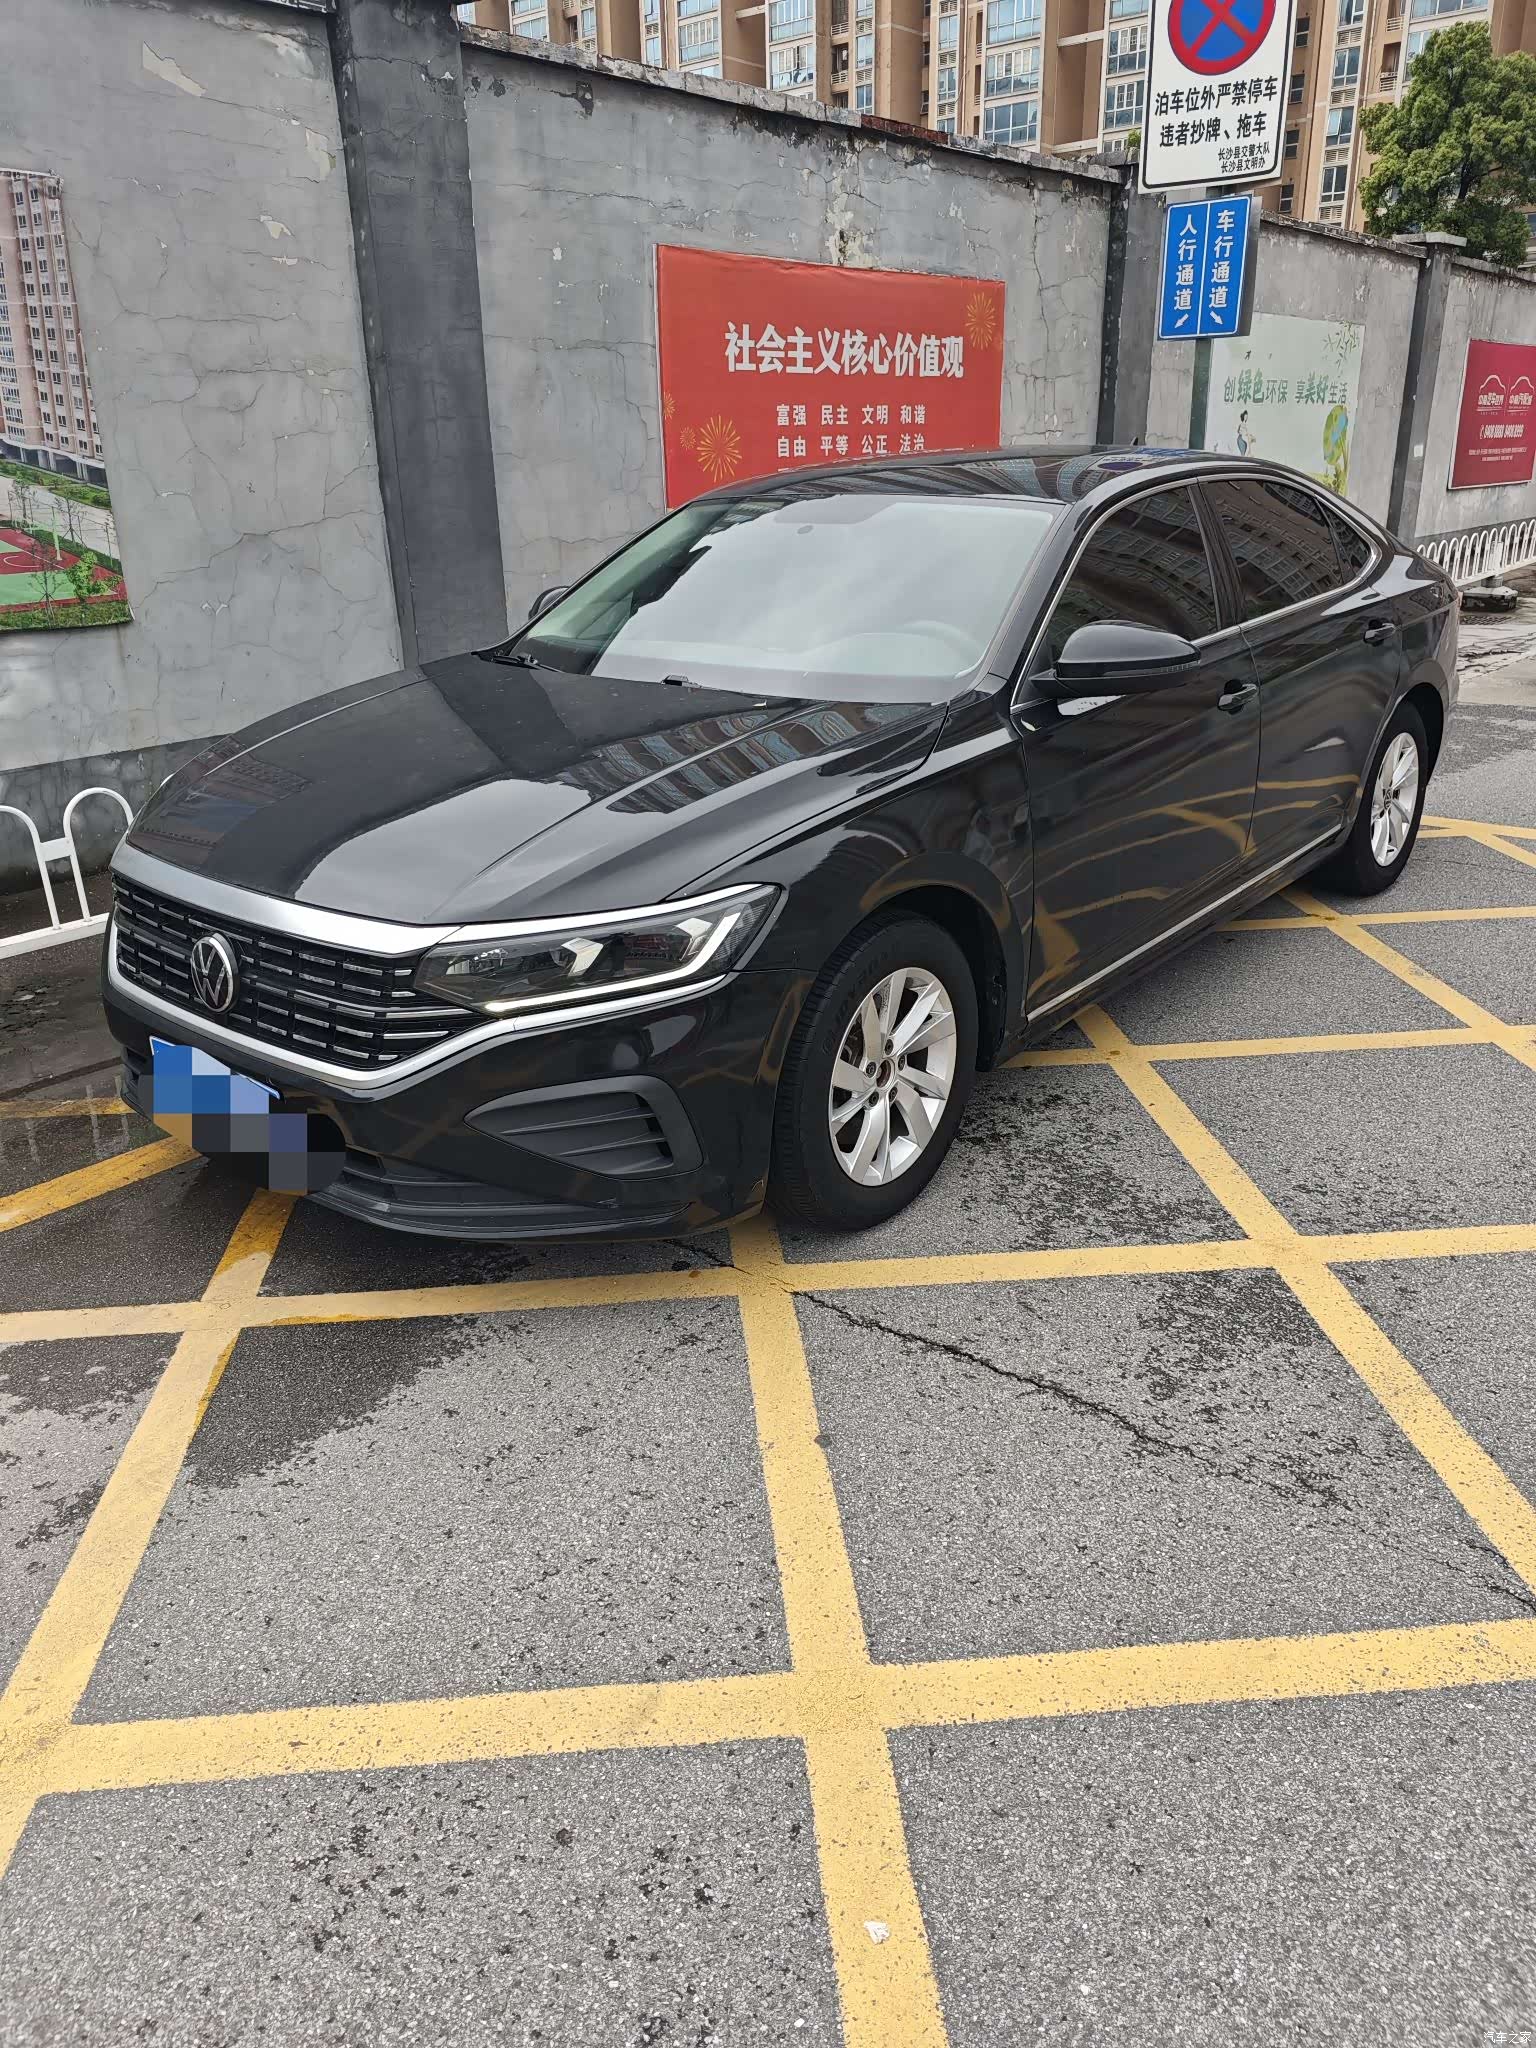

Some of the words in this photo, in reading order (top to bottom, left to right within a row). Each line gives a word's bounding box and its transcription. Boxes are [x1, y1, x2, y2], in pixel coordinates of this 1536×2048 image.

[1154, 75, 1278, 116] 泊车位外严禁停车
[1159, 110, 1267, 148] 违者抄牌、拖车
[1217, 141, 1270, 161] 长沙县交警大队
[1220, 156, 1266, 174] 长沙县文明办
[1173, 214, 1198, 311] 人行通道
[1208, 209, 1236, 309] 车行通道
[724, 321, 965, 379] 社会主义核心价值观
[1223, 367, 1289, 405] 创绿色环保
[1294, 370, 1349, 405] 享美好生活
[776, 403, 807, 427] 富强
[820, 404, 849, 426] 民主
[861, 403, 889, 426] 文明
[900, 403, 927, 426] 和谐
[776, 435, 807, 458] 自由
[819, 434, 850, 457] 平等
[861, 433, 888, 455] 公正
[899, 432, 926, 454] 法治
